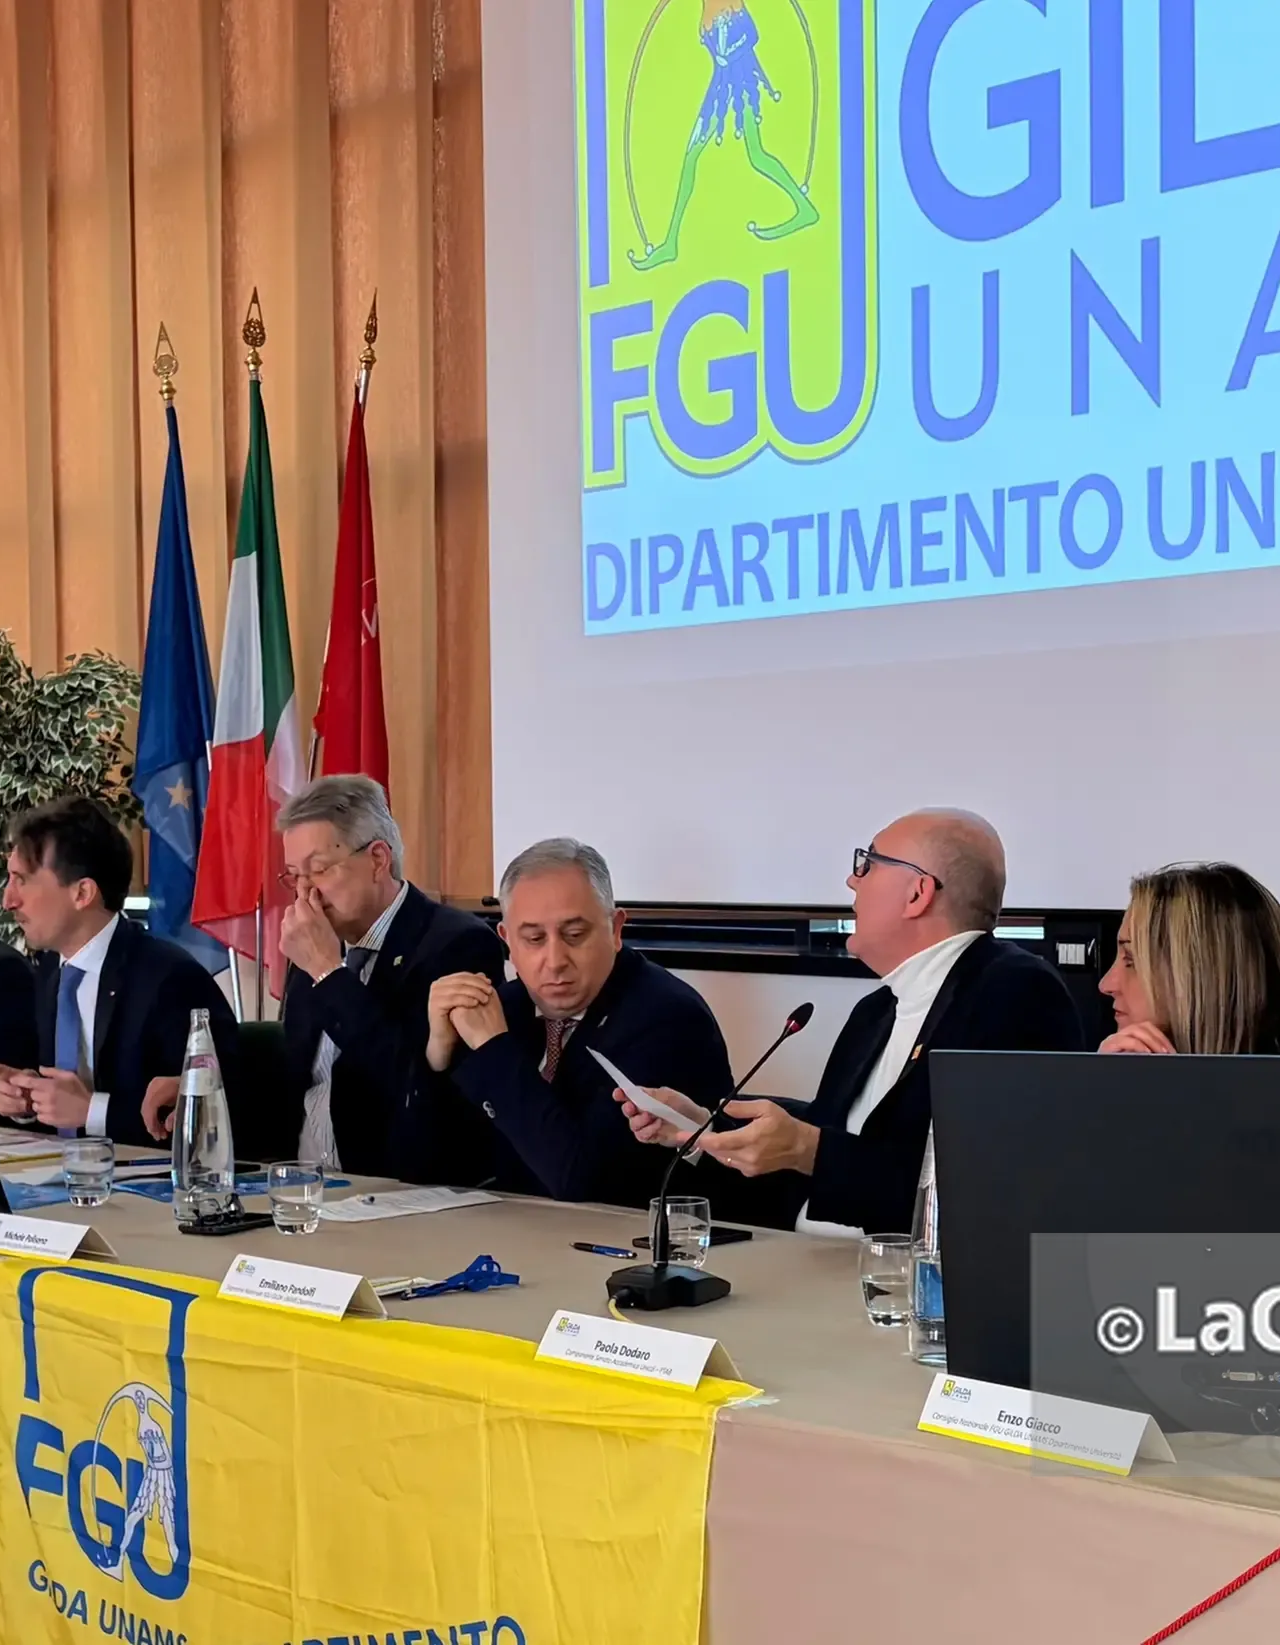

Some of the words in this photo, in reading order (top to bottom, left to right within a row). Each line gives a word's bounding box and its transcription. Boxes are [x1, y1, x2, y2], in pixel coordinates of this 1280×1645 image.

[590, 268, 867, 476] FGU
[586, 472, 1122, 621] DIPARTIMENTO
[594, 1340, 619, 1355] Paola
[619, 1345, 651, 1361] Dodaro
[997, 1410, 1023, 1426] Enzo
[1025, 1416, 1061, 1434] Giacco
[16, 1414, 190, 1600] FGU
